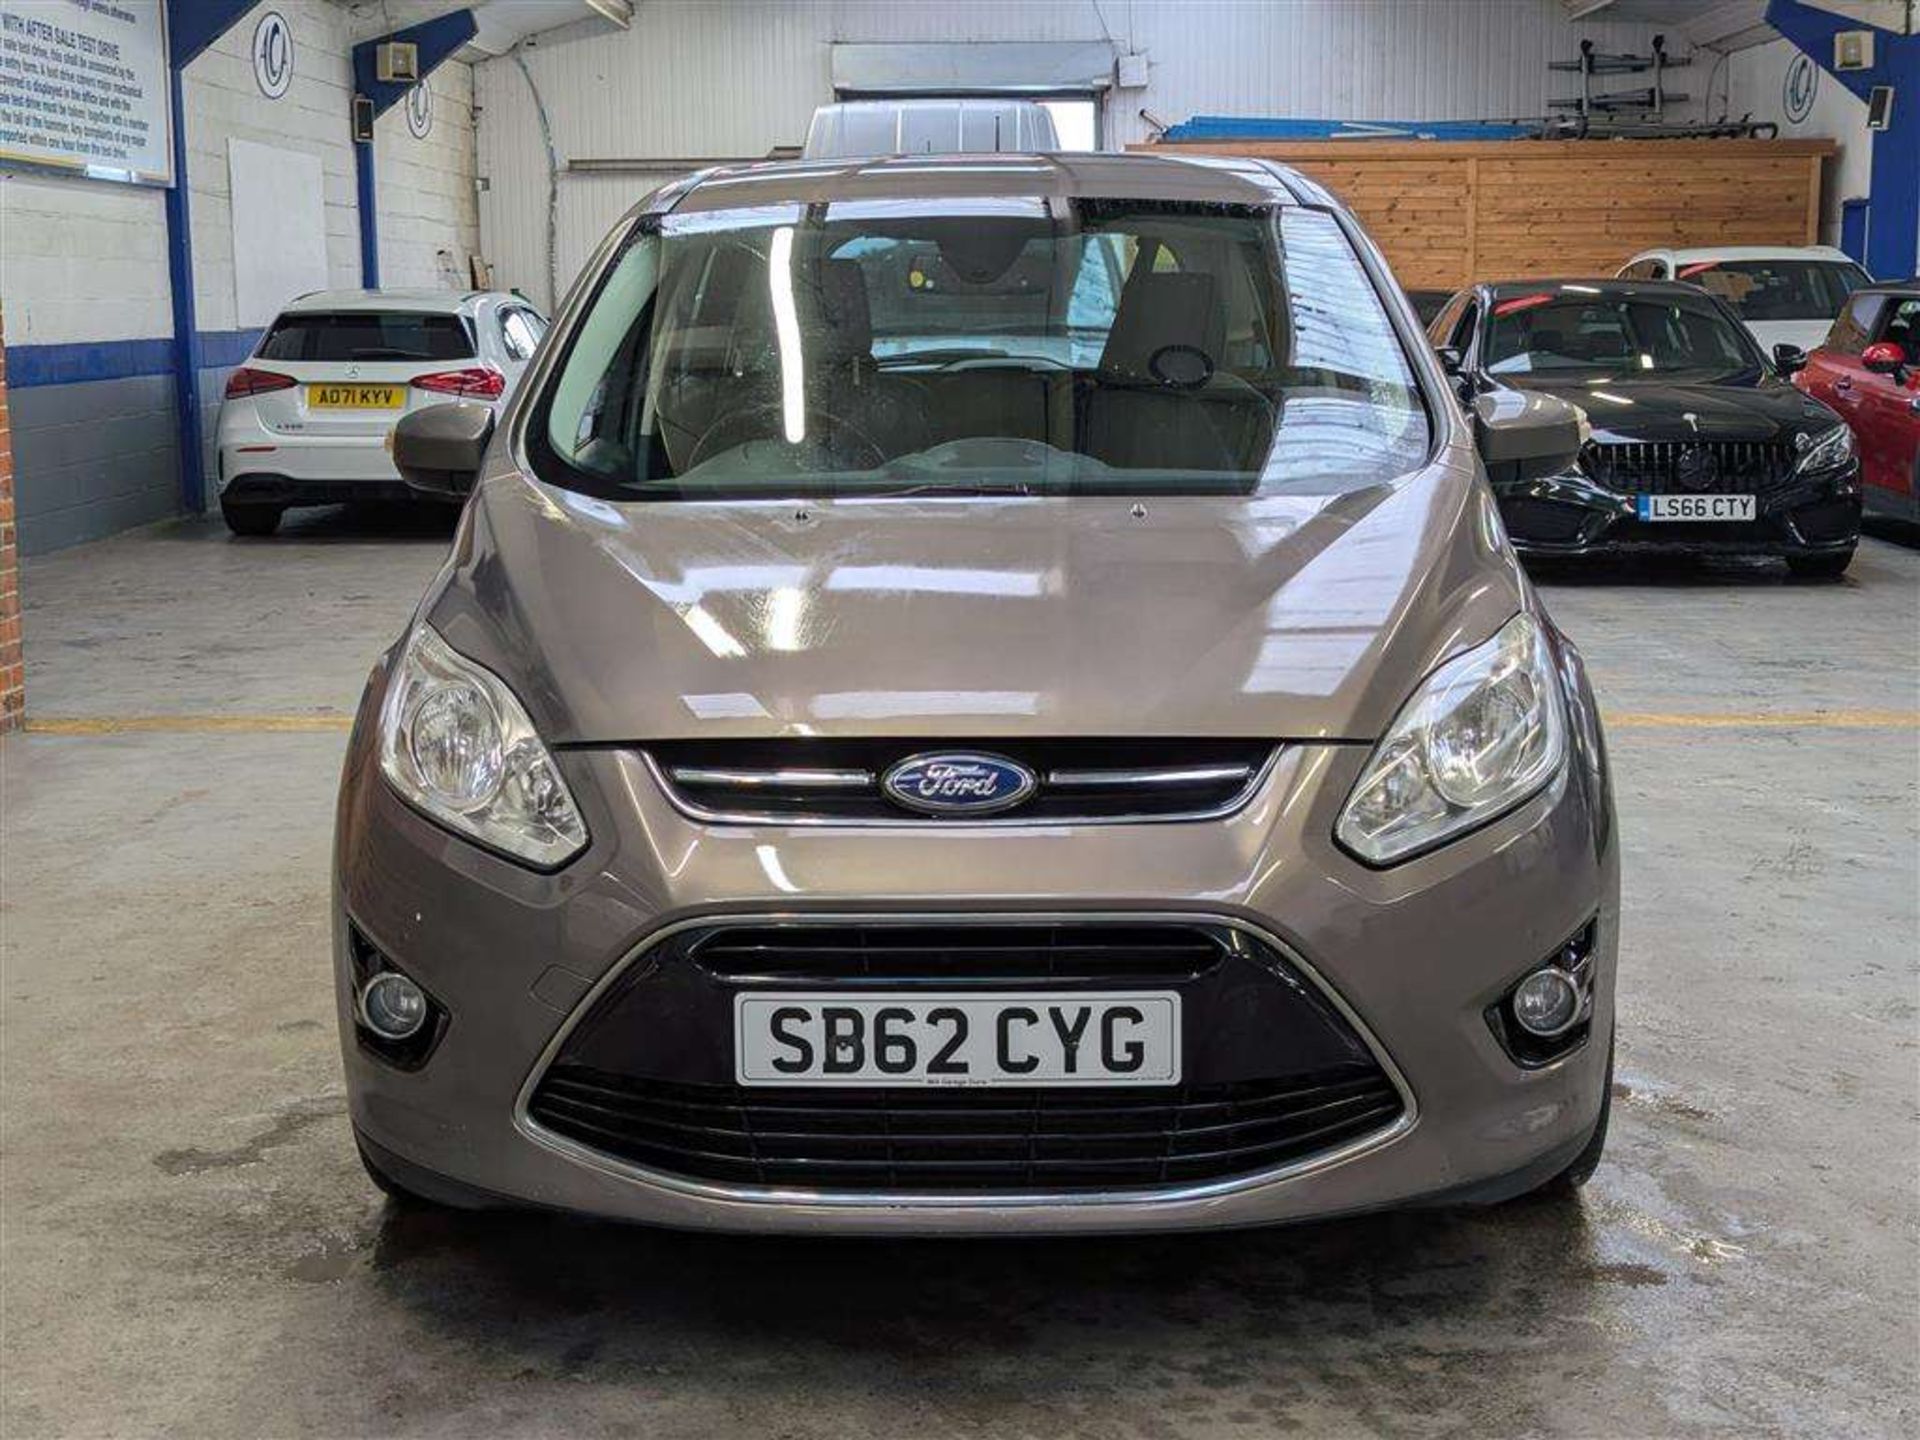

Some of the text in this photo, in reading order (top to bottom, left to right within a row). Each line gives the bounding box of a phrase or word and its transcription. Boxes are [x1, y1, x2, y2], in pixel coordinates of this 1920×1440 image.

[26, 18, 52, 42] AFTER
[54, 26, 76, 49] SALE
[77, 33, 96, 54] TEST
[98, 39, 119, 60] DRIVE
[360, 388, 393, 405] KYV
[1653, 498, 1751, 517] LS66 CTY
[918, 763, 999, 797] Ford
[769, 1006, 1145, 1074] SB62 CYG
